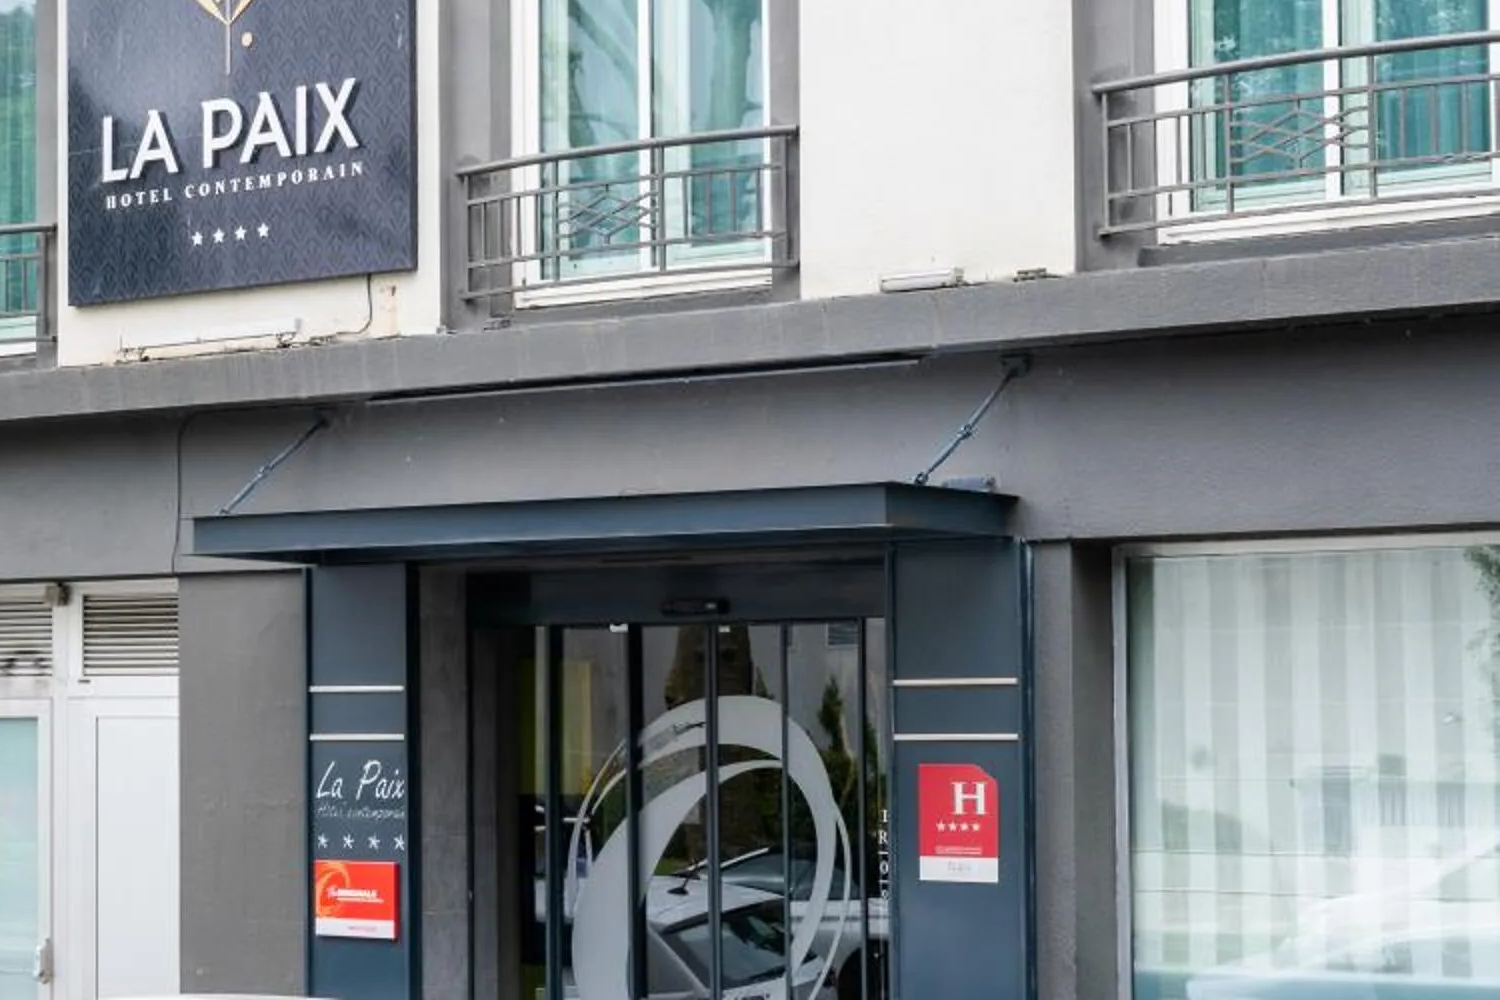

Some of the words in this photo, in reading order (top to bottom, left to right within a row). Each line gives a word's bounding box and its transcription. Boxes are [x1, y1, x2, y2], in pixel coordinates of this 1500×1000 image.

[101, 109, 180, 184] LA
[201, 77, 360, 169] PAIX
[106, 188, 173, 209] HOTEL
[184, 161, 364, 199] CONTEMPORAIN
[316, 761, 343, 799] La
[355, 760, 405, 800] Paix
[952, 782, 987, 815] H
